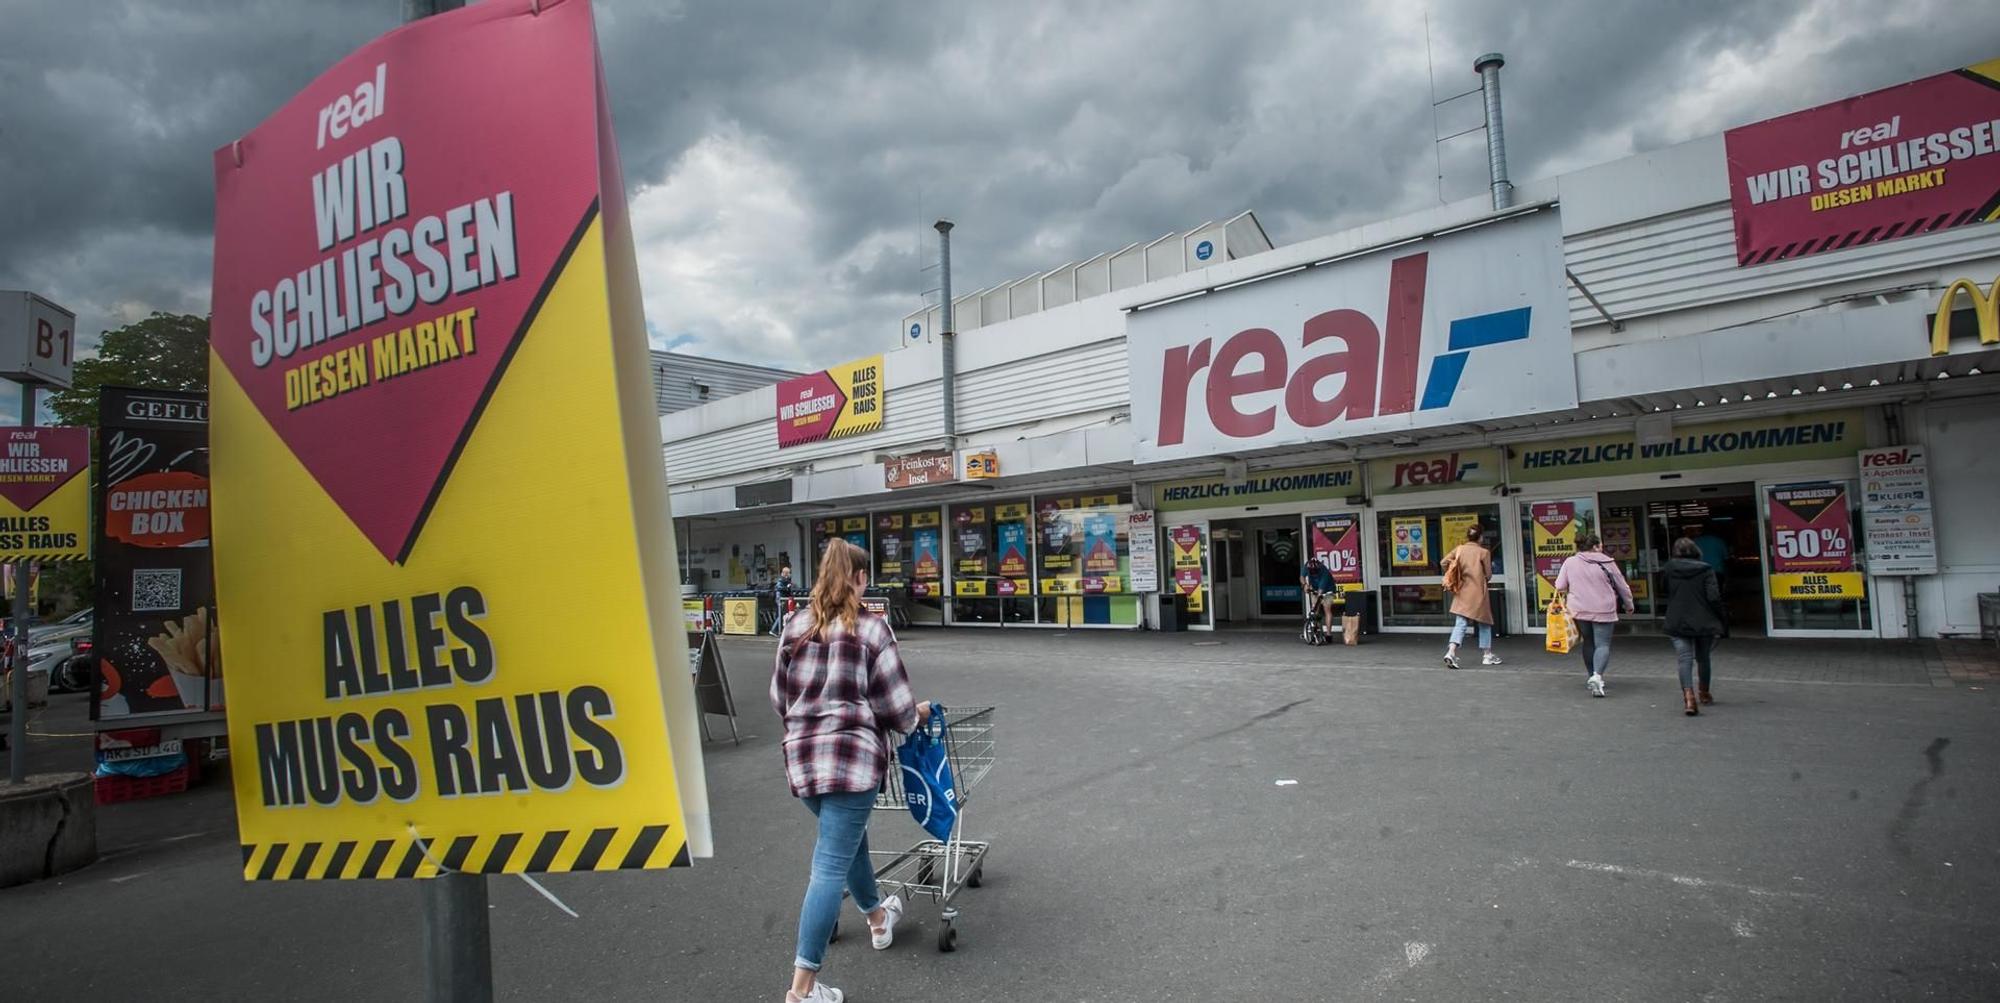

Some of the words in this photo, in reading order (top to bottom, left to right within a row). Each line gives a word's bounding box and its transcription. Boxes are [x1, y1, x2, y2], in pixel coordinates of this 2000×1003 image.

[317, 62, 387, 150] real
[1841, 115, 1901, 149] real
[312, 136, 408, 251] WIR
[1746, 164, 1812, 205] WIR
[1811, 184, 1873, 212] DIESEN
[1876, 168, 1946, 198] MARKT
[250, 191, 519, 368] SCHLIESSEN
[37, 318, 70, 366] B1
[285, 350, 368, 411] DIESEN
[372, 307, 477, 382] MARKT
[852, 366, 877, 384] ALLES
[852, 382, 877, 400] MUSS
[780, 404, 794, 421] WIR
[853, 398, 877, 416] RAUS
[8, 442, 40, 458] WIR
[1523, 442, 1634, 469] HERZLICH
[1640, 422, 1845, 458] WILLKOMMEN!
[901, 456, 935, 470] Feinkost
[908, 471, 929, 485] Insel
[111, 489, 209, 511] CHICKEN
[1163, 483, 1229, 501] HERZLICH
[1234, 471, 1353, 495] WILLKOMMEN!
[0, 517, 50, 532] ALLES
[131, 511, 185, 535] BOX
[28, 533, 77, 549] RAUS
[1776, 528, 1847, 559] 50%
[1802, 575, 1828, 585] ALLES
[323, 585, 497, 700] ALLES
[254, 708, 420, 808] MUSS
[425, 685, 627, 797] RAUS
